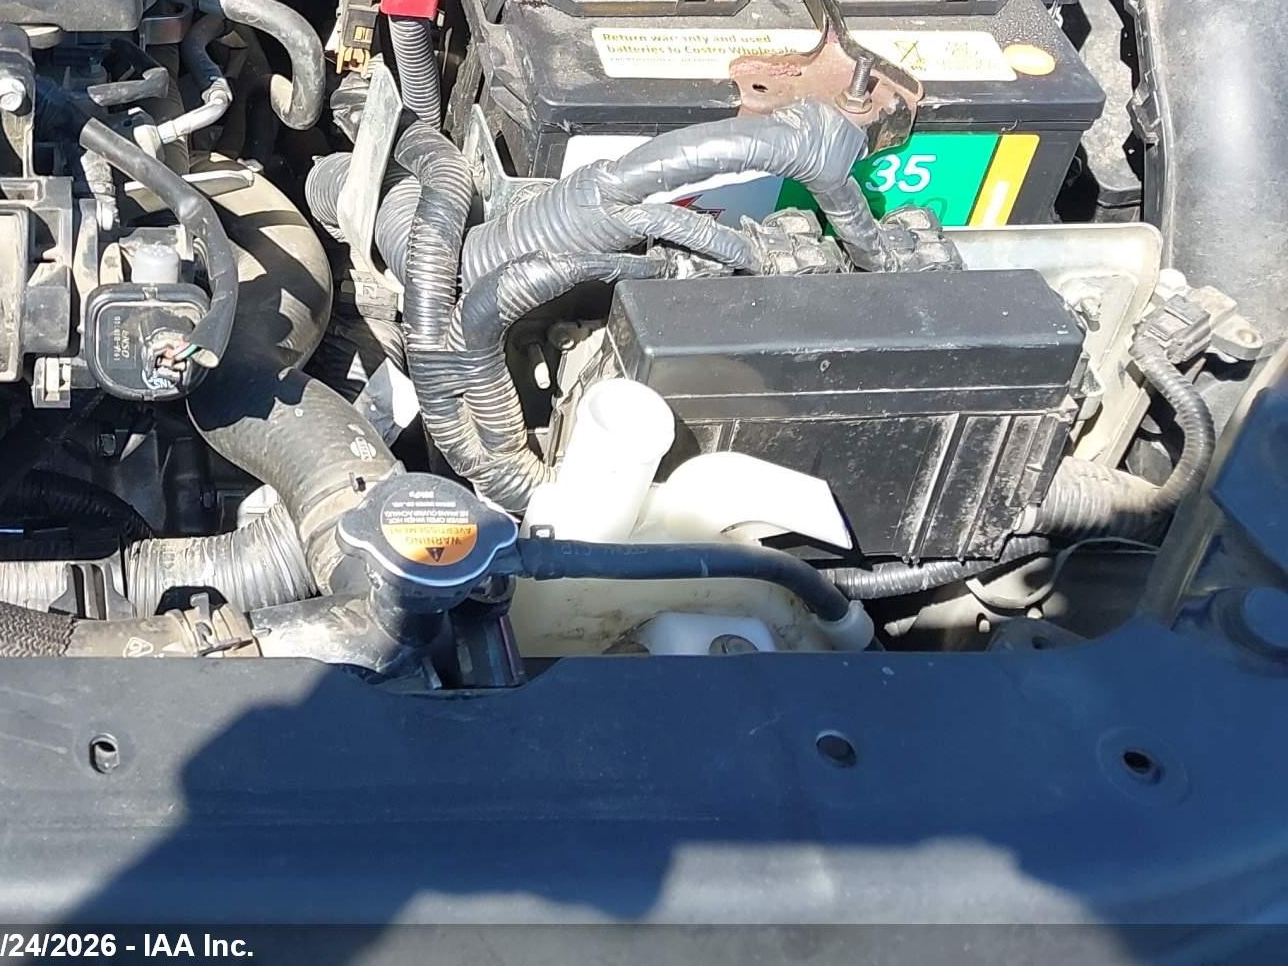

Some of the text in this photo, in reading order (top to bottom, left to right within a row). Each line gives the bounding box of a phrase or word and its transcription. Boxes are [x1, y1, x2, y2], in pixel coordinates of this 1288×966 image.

[602, 33, 647, 42] Return
[713, 34, 737, 42] and
[741, 34, 771, 43] used
[607, 45, 665, 54] batteries
[668, 45, 681, 54] to
[684, 45, 725, 54] Costco
[865, 153, 937, 193] 35
[404, 537, 463, 546] WARNING
